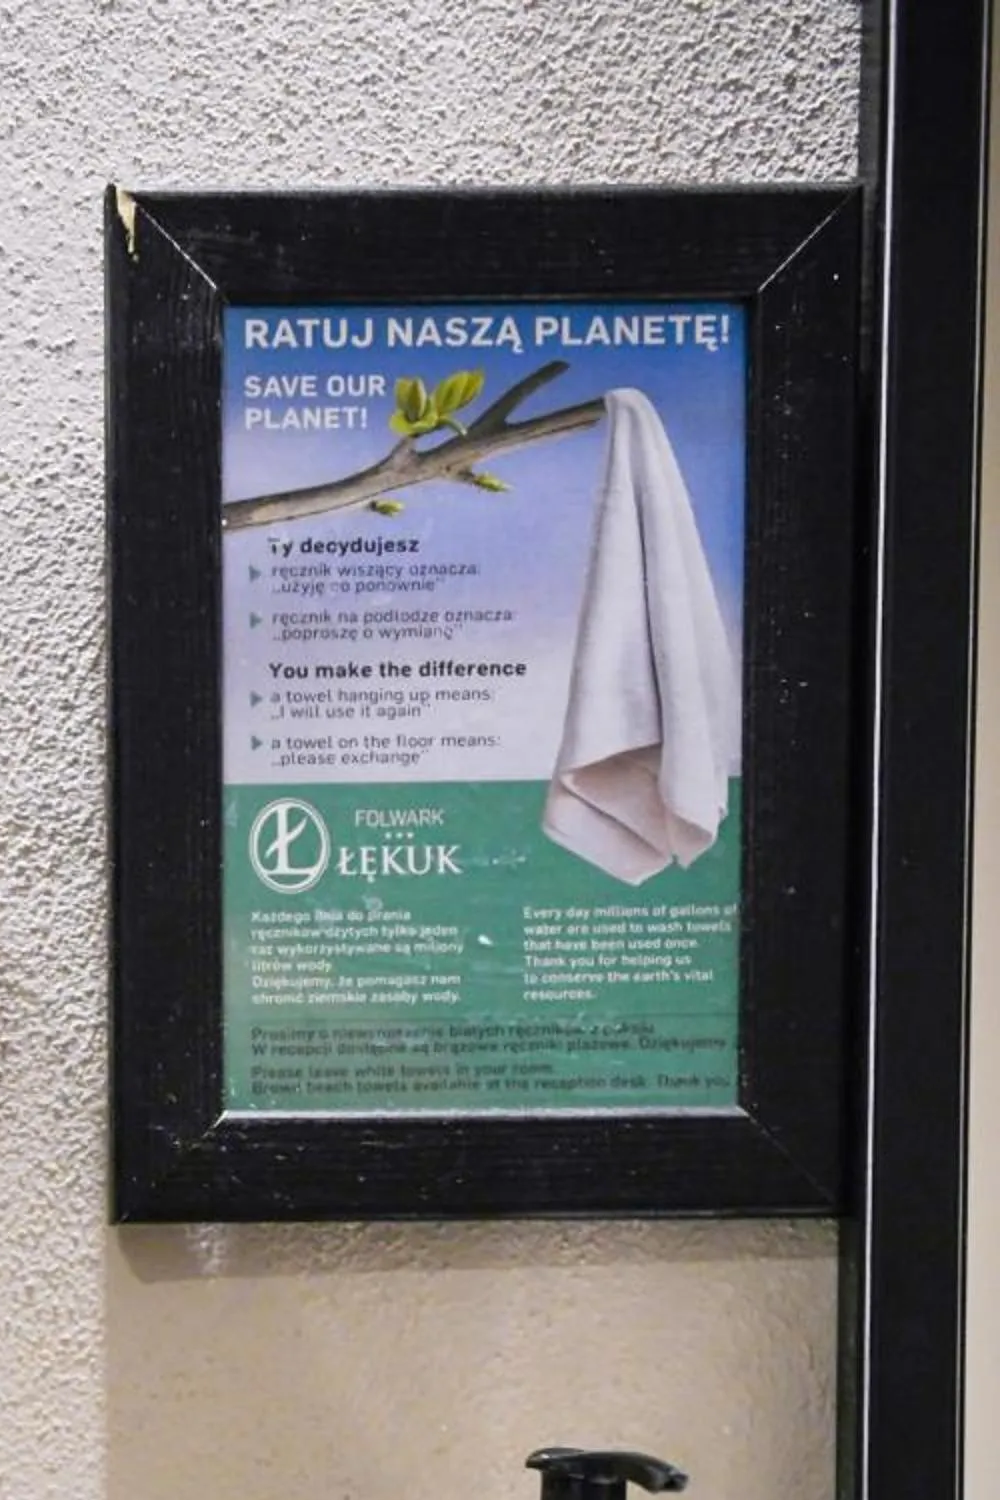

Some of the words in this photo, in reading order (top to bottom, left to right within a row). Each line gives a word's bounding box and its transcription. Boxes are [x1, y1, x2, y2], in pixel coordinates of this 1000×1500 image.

[245, 317, 374, 349] RATUJ
[387, 316, 524, 353] NASZĄ
[535, 313, 731, 351] PLANETĘ!
[245, 375, 318, 398] SAVE
[331, 374, 387, 397] OUR
[246, 406, 368, 430] PLANET!
[300, 536, 419, 557] decydujesz
[271, 562, 331, 581] ręcznik
[337, 562, 403, 581] wiszący
[271, 608, 331, 627] ręcznik
[337, 611, 359, 624] na
[363, 627, 374, 639] o
[269, 661, 309, 679] You
[315, 660, 373, 679] make
[379, 659, 412, 678] the
[419, 658, 527, 678] difference
[270, 691, 281, 703] a
[286, 688, 332, 703] towel
[338, 687, 405, 705] hanging
[409, 690, 431, 706] up
[290, 703, 320, 718] will
[326, 705, 355, 718] use
[361, 703, 371, 718] it
[271, 737, 281, 749] a
[286, 735, 333, 750] towel
[338, 736, 359, 749] on
[363, 734, 391, 750] the
[396, 733, 433, 749] floor
[354, 808, 445, 828] FOLWARK
[336, 844, 464, 884] ŁĘKUK
[523, 906, 563, 921] Every
[566, 905, 590, 920] day
[593, 904, 649, 918] millions
[652, 904, 667, 918] of
[669, 902, 721, 918] gallons
[523, 923, 563, 936] water
[566, 924, 589, 935] are
[592, 922, 626, 935] used
[629, 922, 644, 934] to
[647, 920, 683, 934] wash
[554, 938, 588, 951] have
[590, 936, 625, 951] been
[627, 936, 662, 950] used
[525, 954, 565, 968] Thank
[568, 956, 595, 969] you
[598, 953, 617, 968] for
[621, 952, 672, 968] helping
[675, 954, 693, 966] us
[607, 969, 630, 983] the
[684, 968, 714, 982] vital
